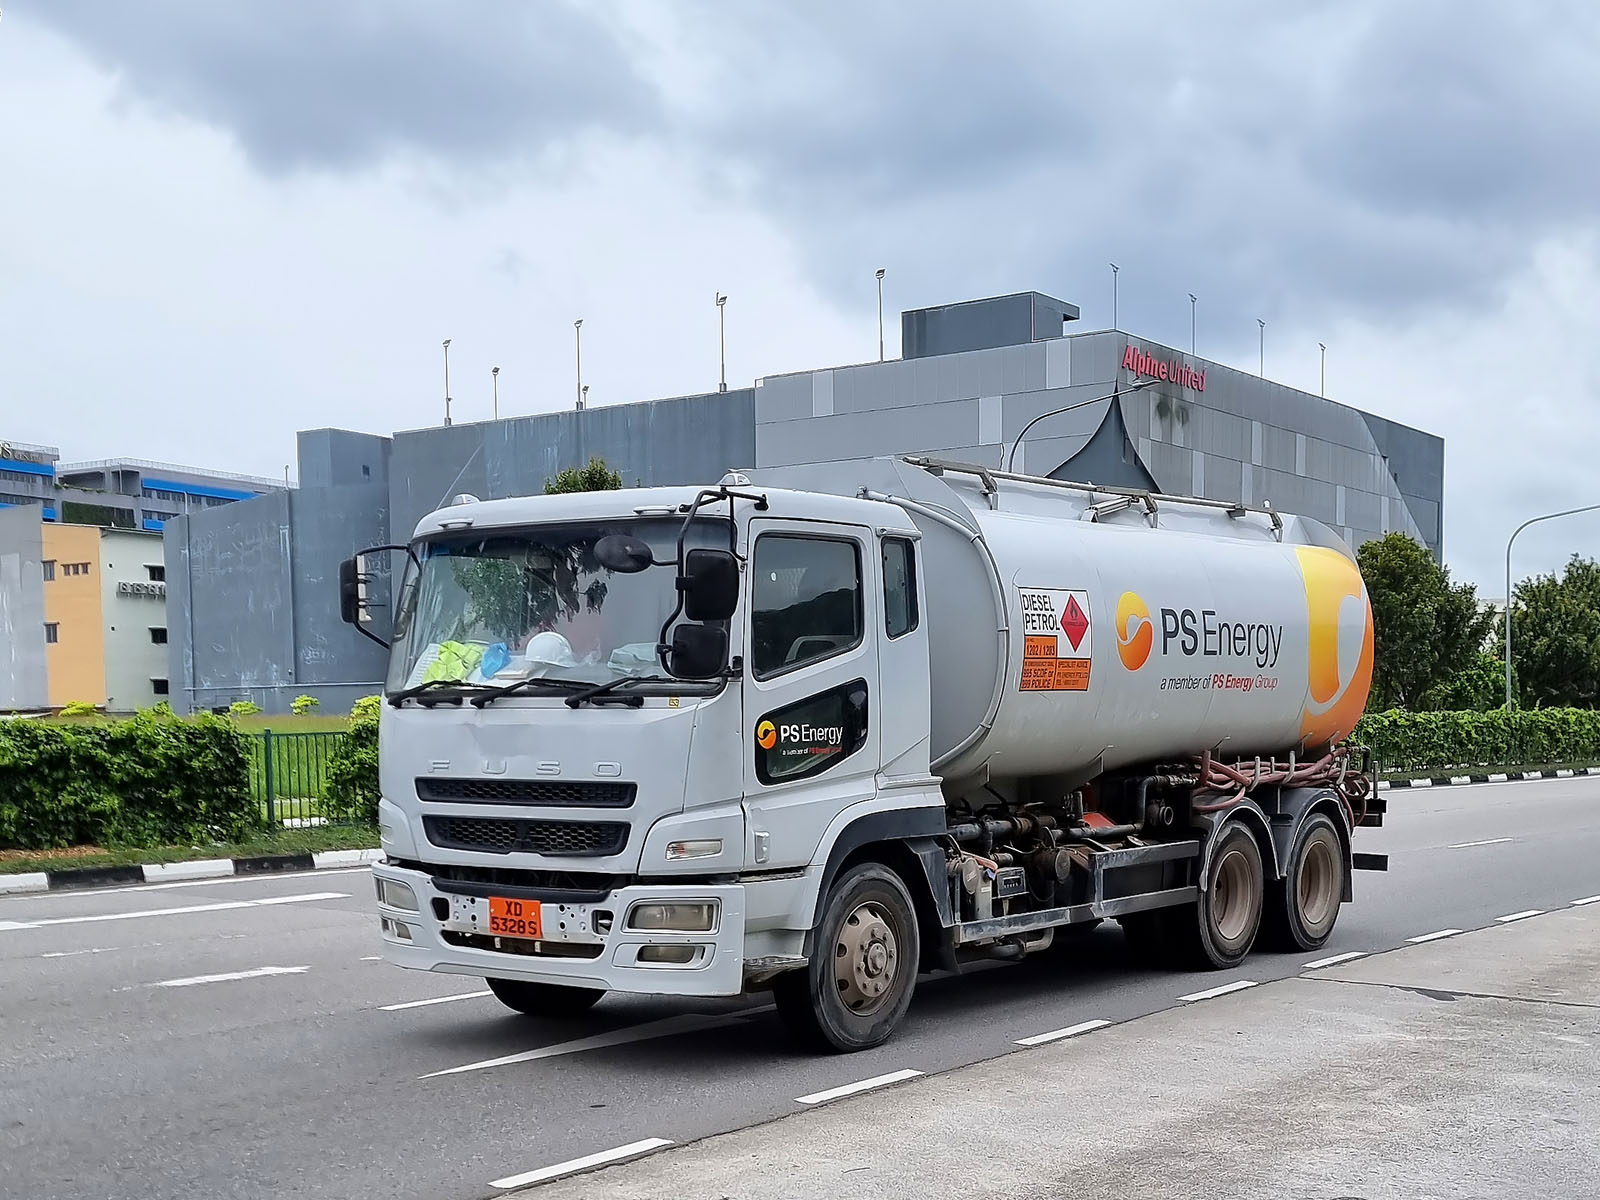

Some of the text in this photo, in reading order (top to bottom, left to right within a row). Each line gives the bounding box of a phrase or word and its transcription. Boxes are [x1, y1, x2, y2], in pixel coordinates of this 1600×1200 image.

[1122, 344, 1208, 392] Alpine United
[1022, 594, 1055, 612] DIESEL
[1025, 613, 1060, 631] PETROL
[1202, 610, 1283, 669] Energy
[1031, 679, 1051, 689] POLICE
[1160, 674, 1279, 692] a member of PS Energy Group
[780, 724, 844, 745] PS Energy
[428, 759, 622, 777] FUSO
[505, 900, 523, 917] XD
